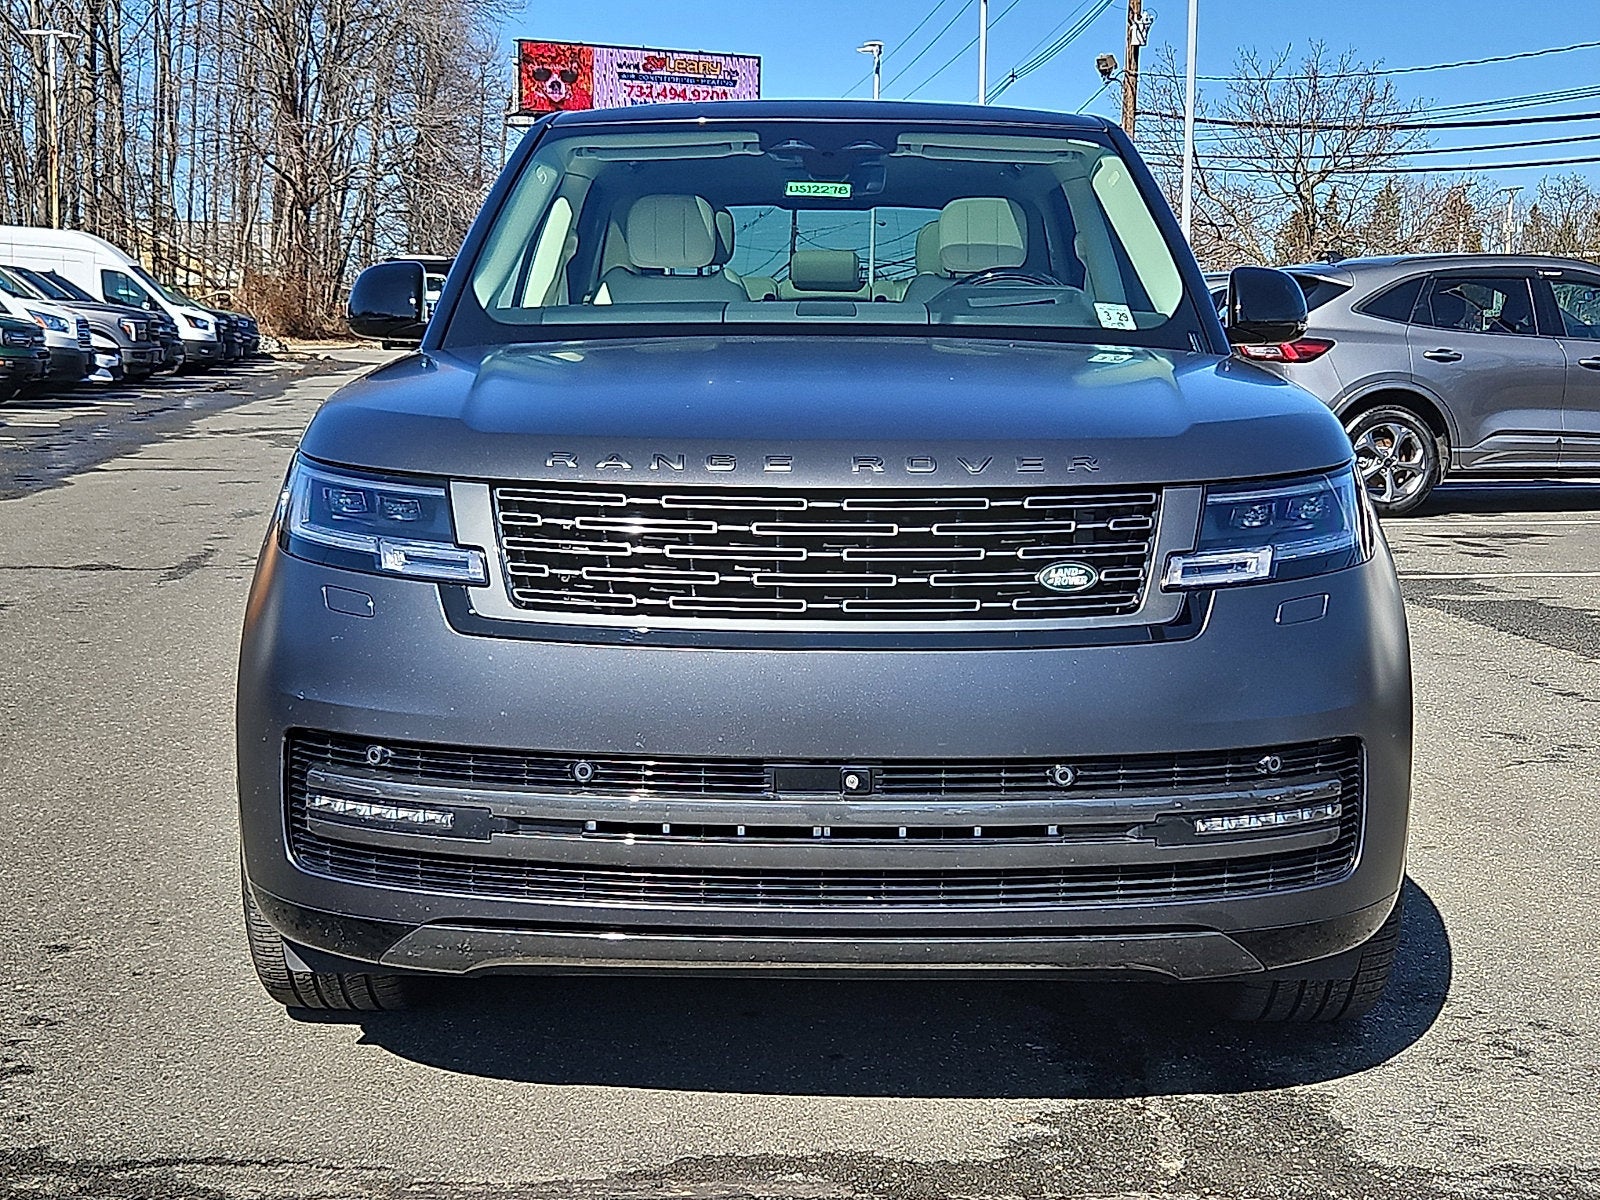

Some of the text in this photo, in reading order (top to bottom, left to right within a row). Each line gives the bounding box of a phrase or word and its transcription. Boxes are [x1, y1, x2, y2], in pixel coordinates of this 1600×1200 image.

[1103, 310, 1112, 321] 3
[545, 451, 1100, 475] RANGE ROVER
[1049, 567, 1080, 578] LAND
